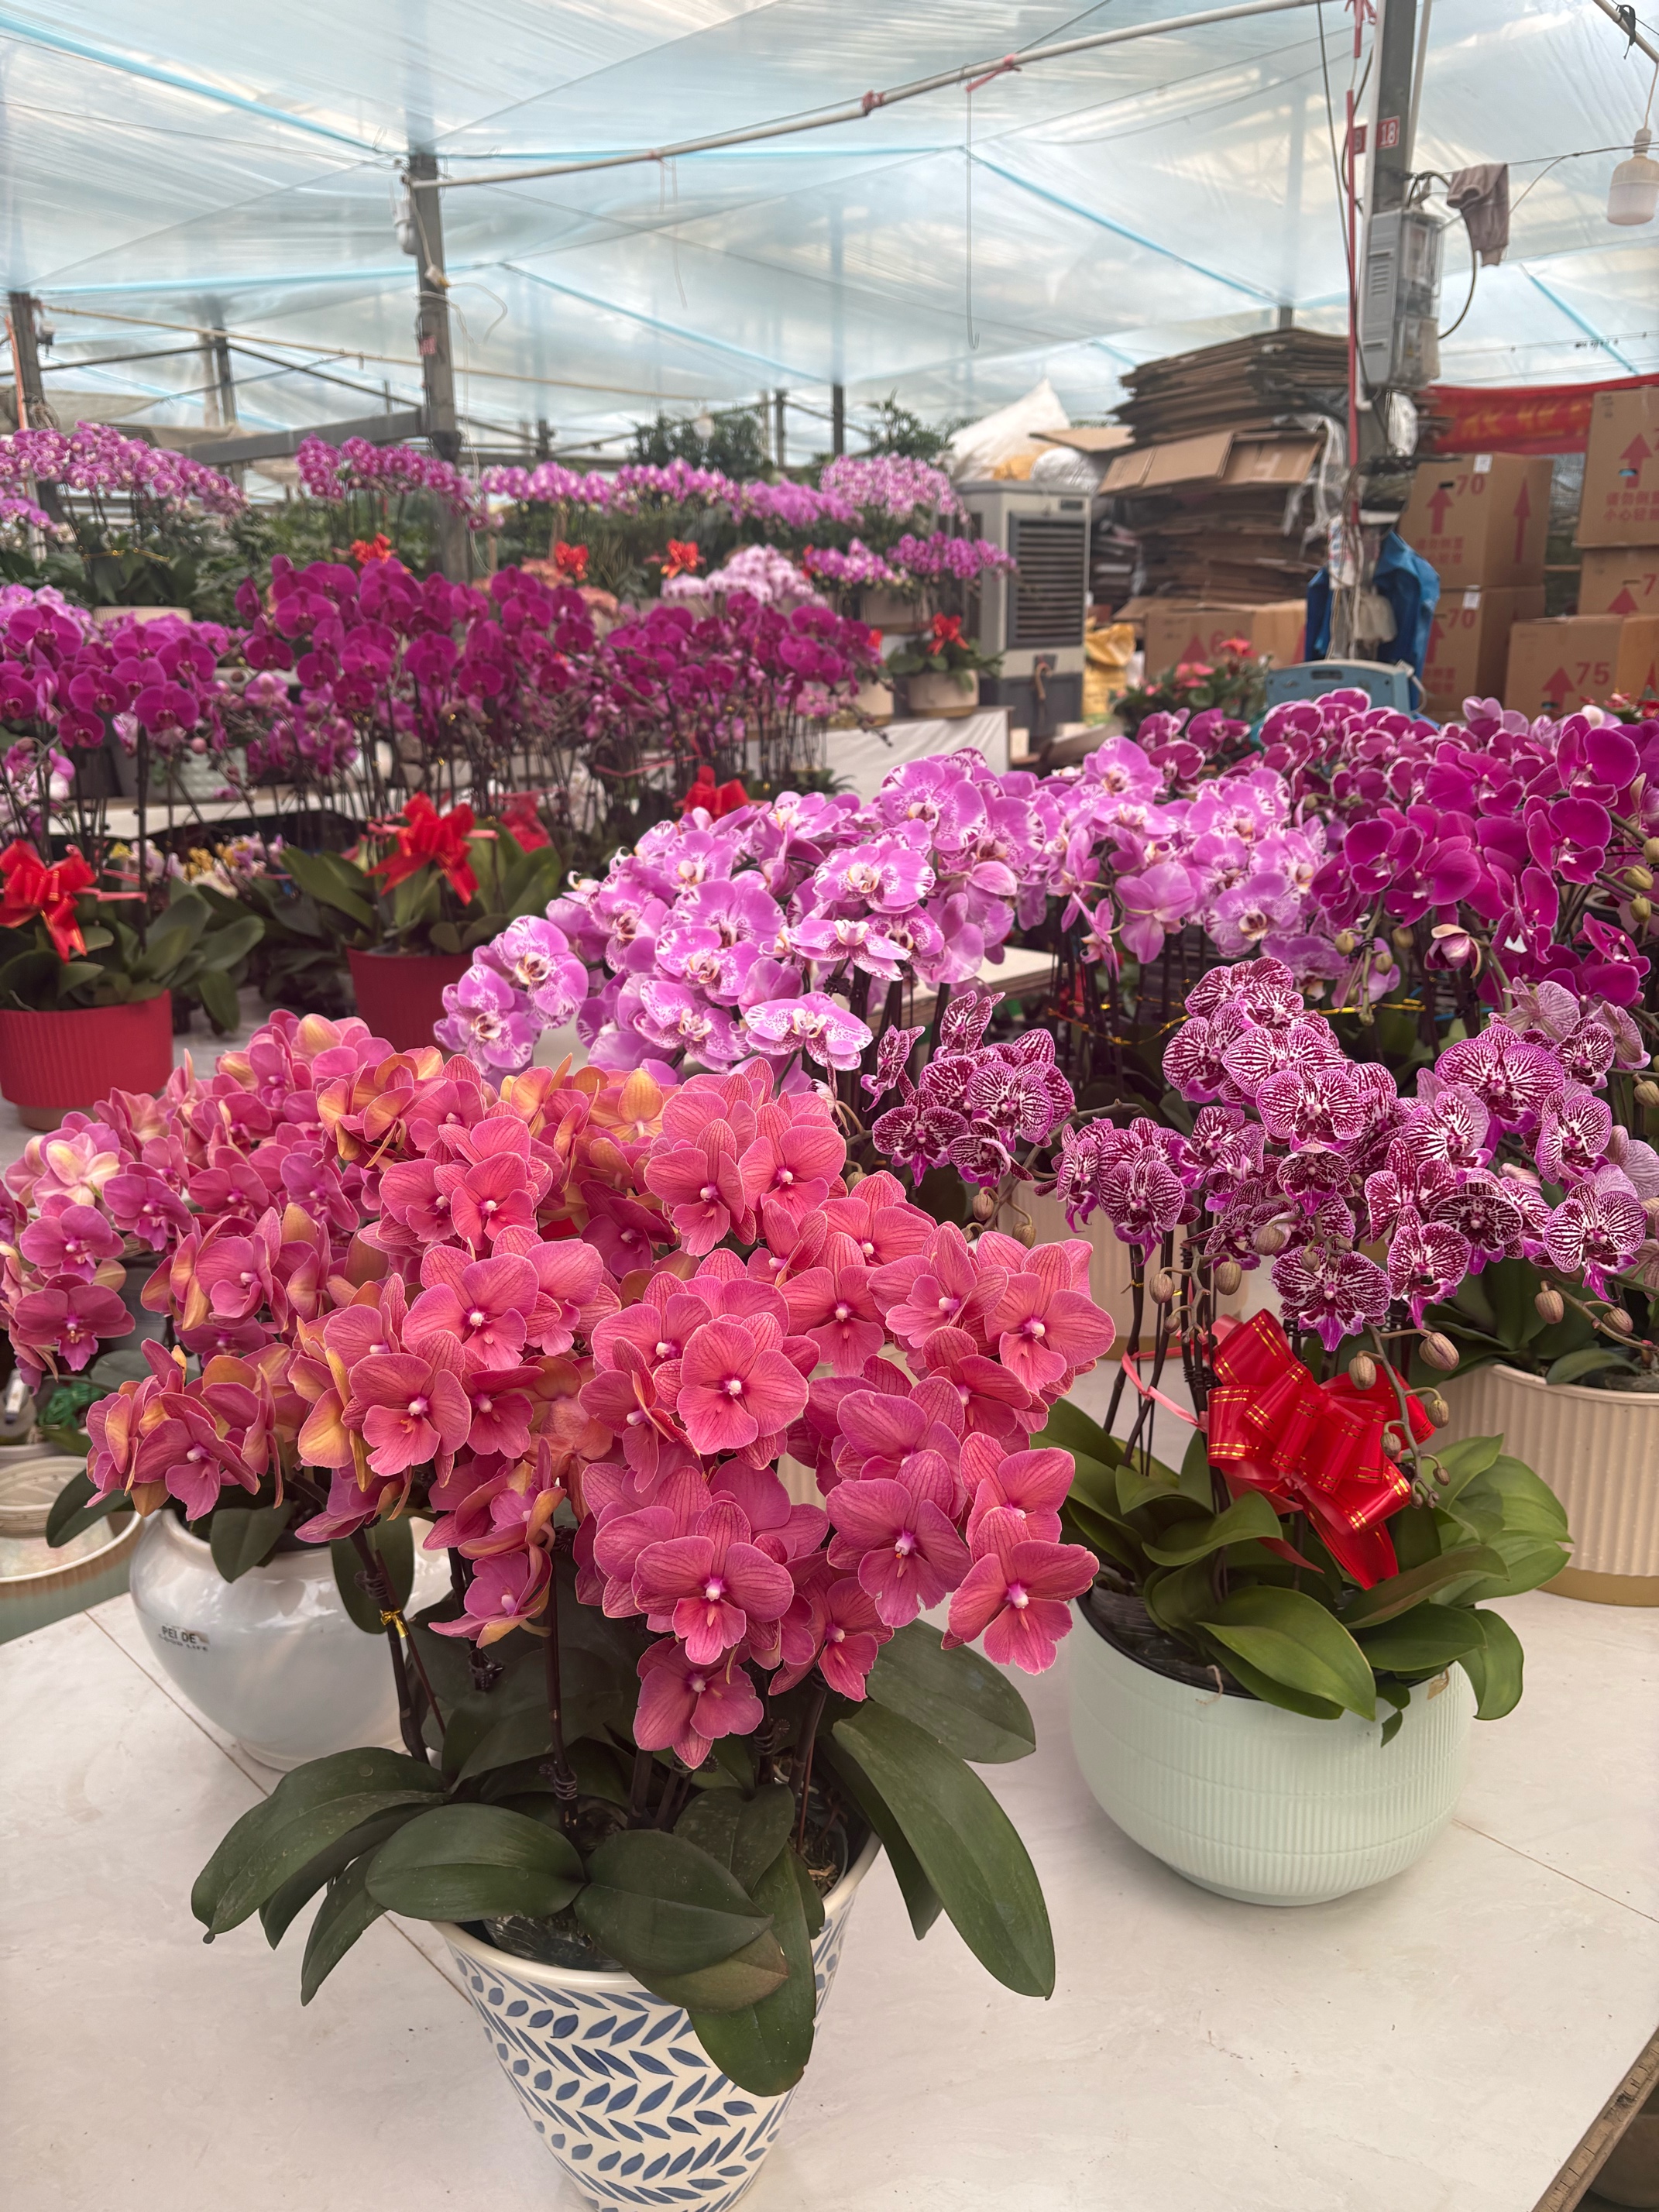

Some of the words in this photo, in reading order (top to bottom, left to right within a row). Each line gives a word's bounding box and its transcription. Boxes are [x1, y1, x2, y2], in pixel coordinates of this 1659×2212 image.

[1379, 122, 1396, 146] 18
[1456, 474, 1486, 496] 70
[1448, 607, 1476, 629] 70
[1575, 661, 1610, 686] 75
[162, 1626, 178, 1640] PEI
[181, 1631, 197, 1644] DE
